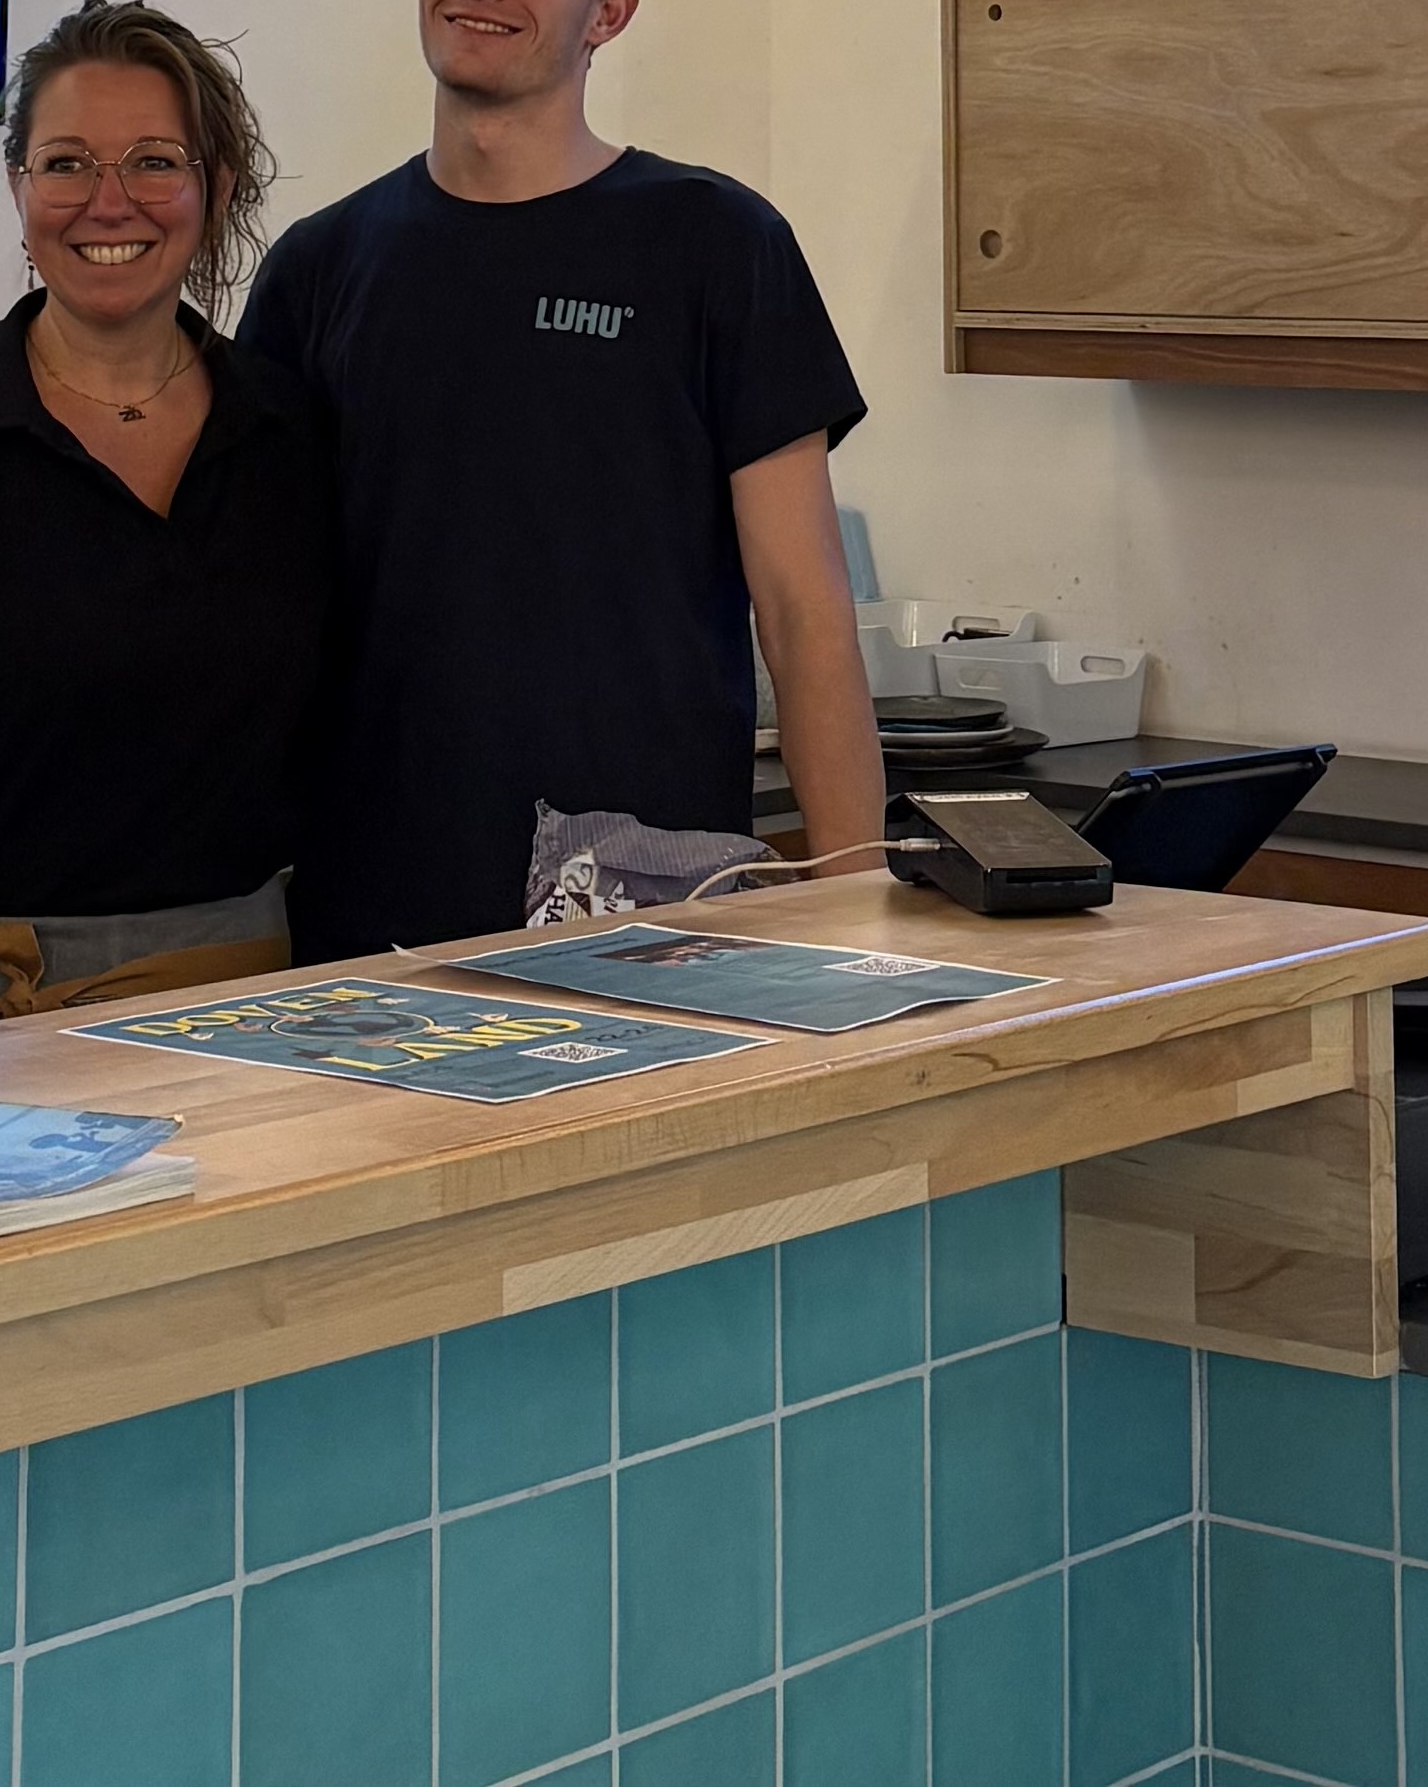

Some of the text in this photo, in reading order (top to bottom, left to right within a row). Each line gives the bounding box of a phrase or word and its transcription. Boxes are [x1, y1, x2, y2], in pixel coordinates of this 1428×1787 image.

[534, 296, 623, 339] LUHU
[122, 987, 379, 1037] DOVEN
[322, 1016, 583, 1071] LAND
